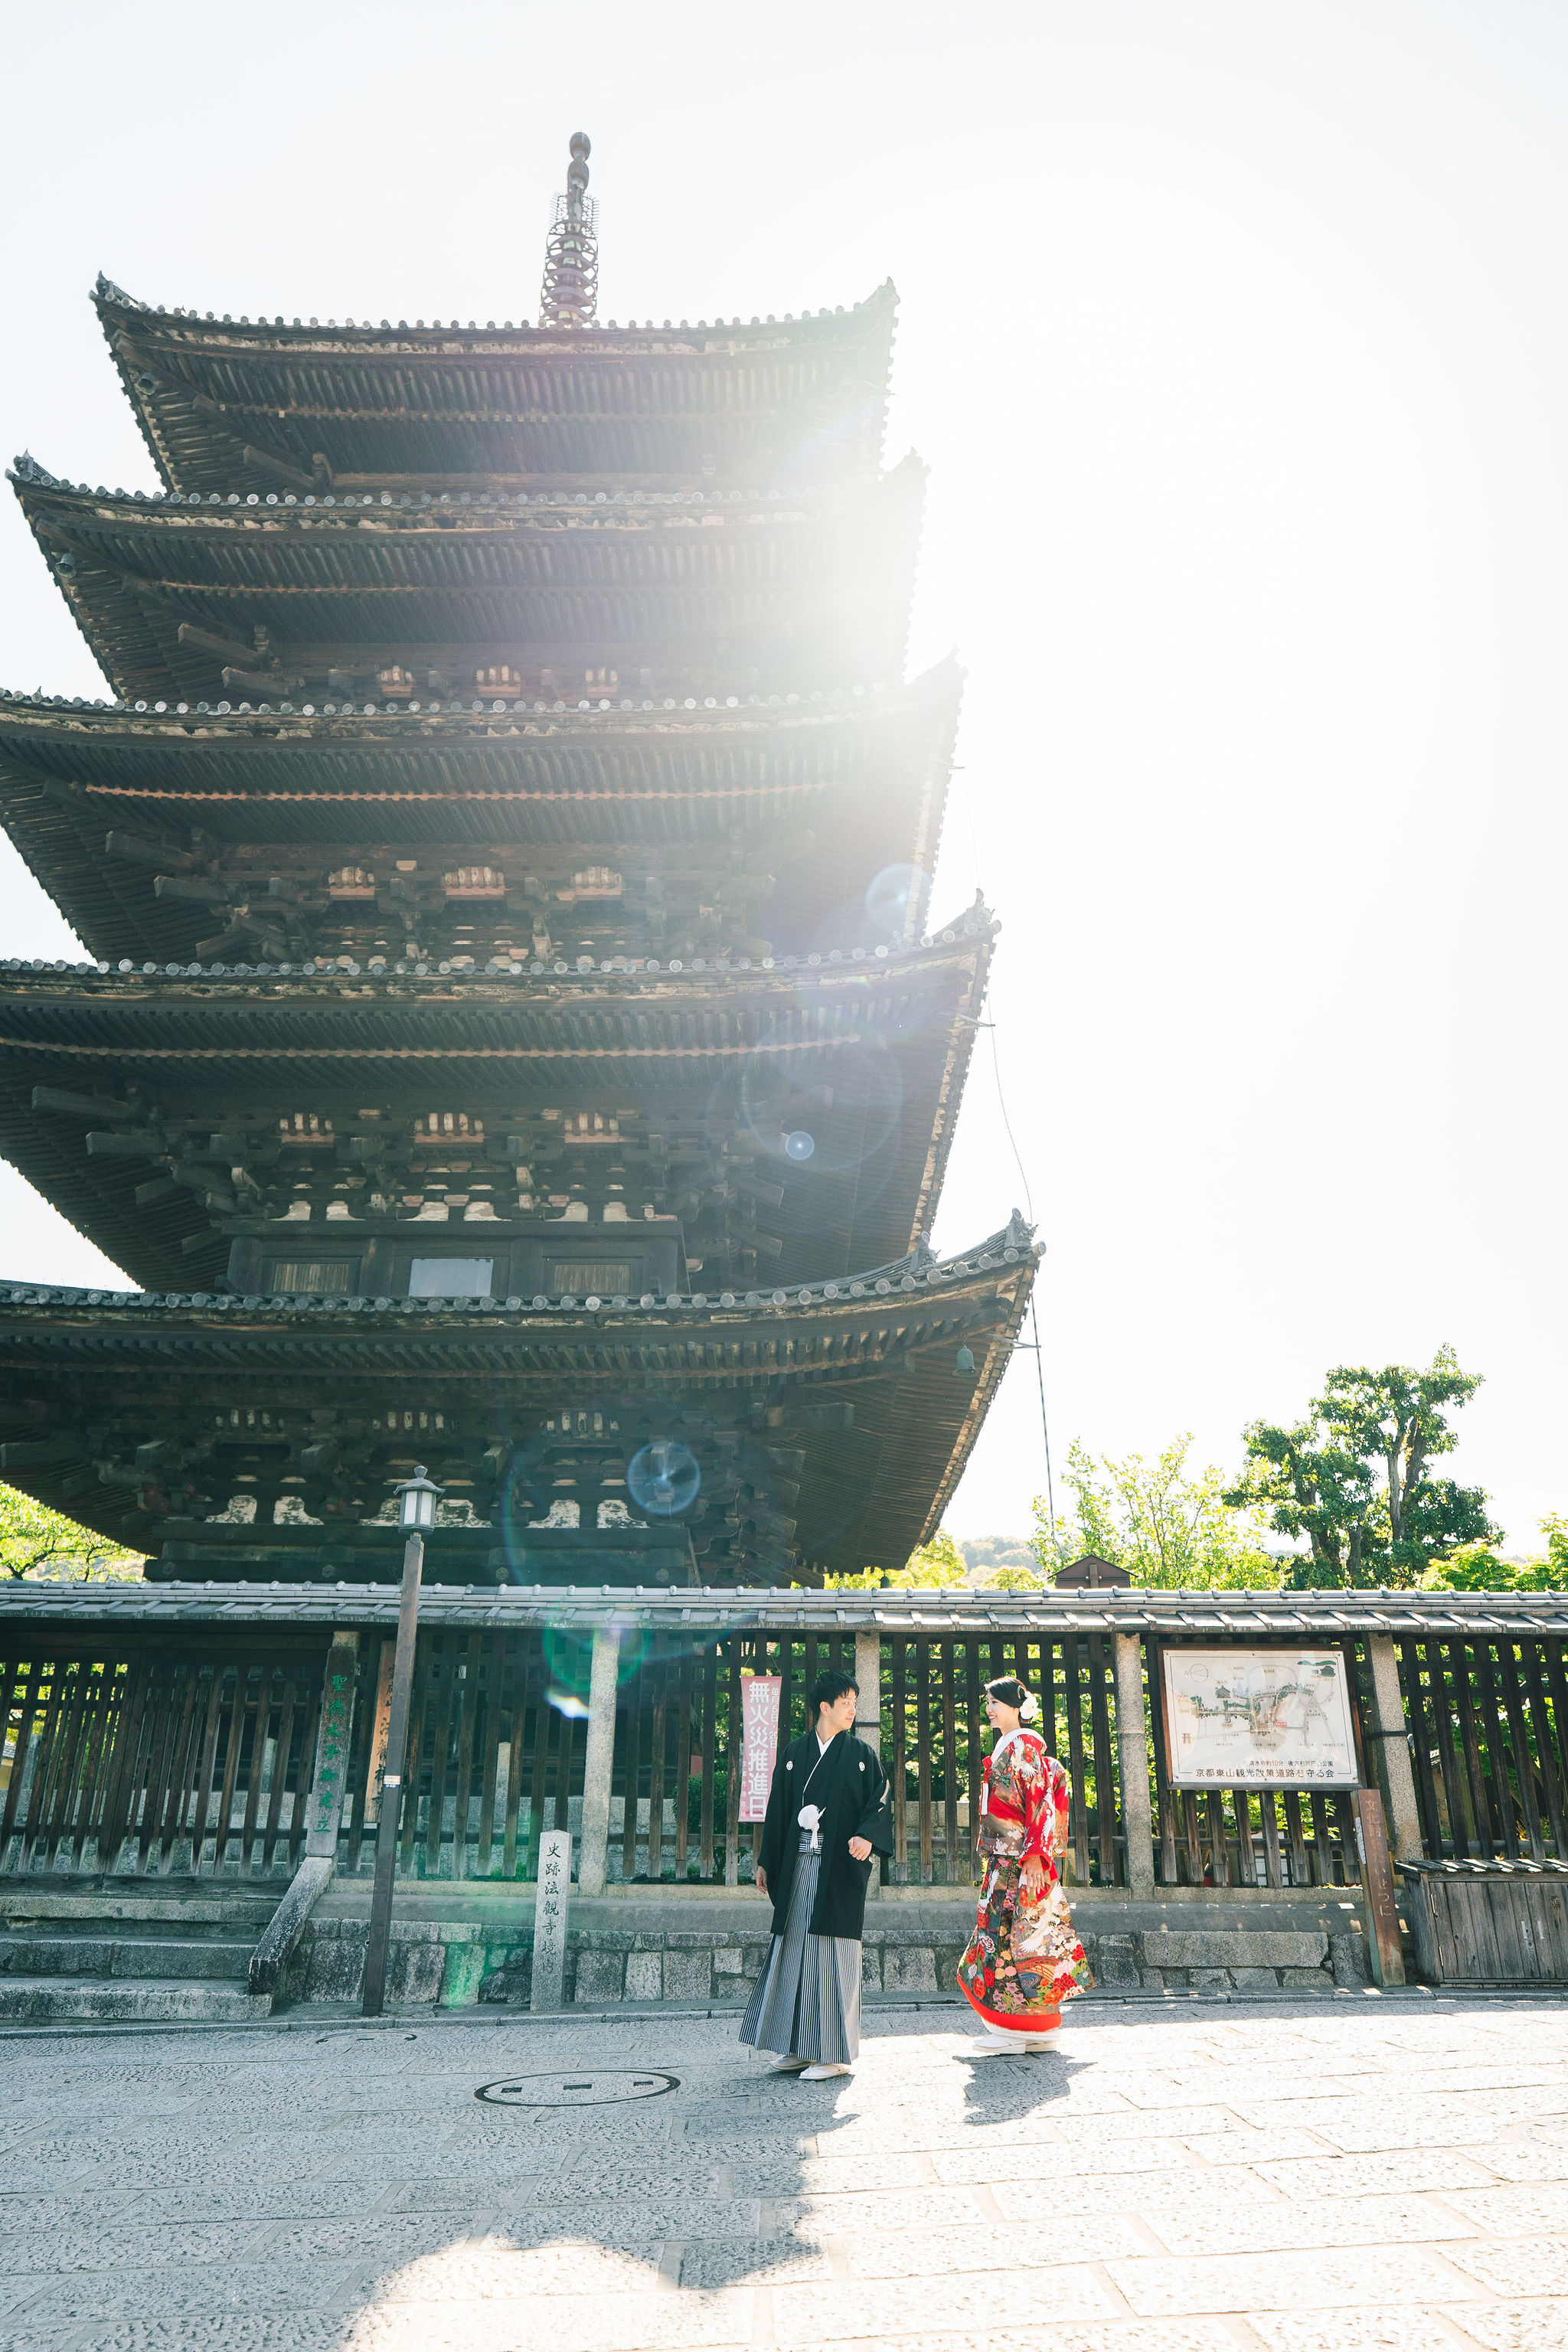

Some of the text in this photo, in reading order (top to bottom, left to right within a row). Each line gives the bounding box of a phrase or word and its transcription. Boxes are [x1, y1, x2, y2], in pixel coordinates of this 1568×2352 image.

[748, 1681, 769, 1818] 無火災推進日
